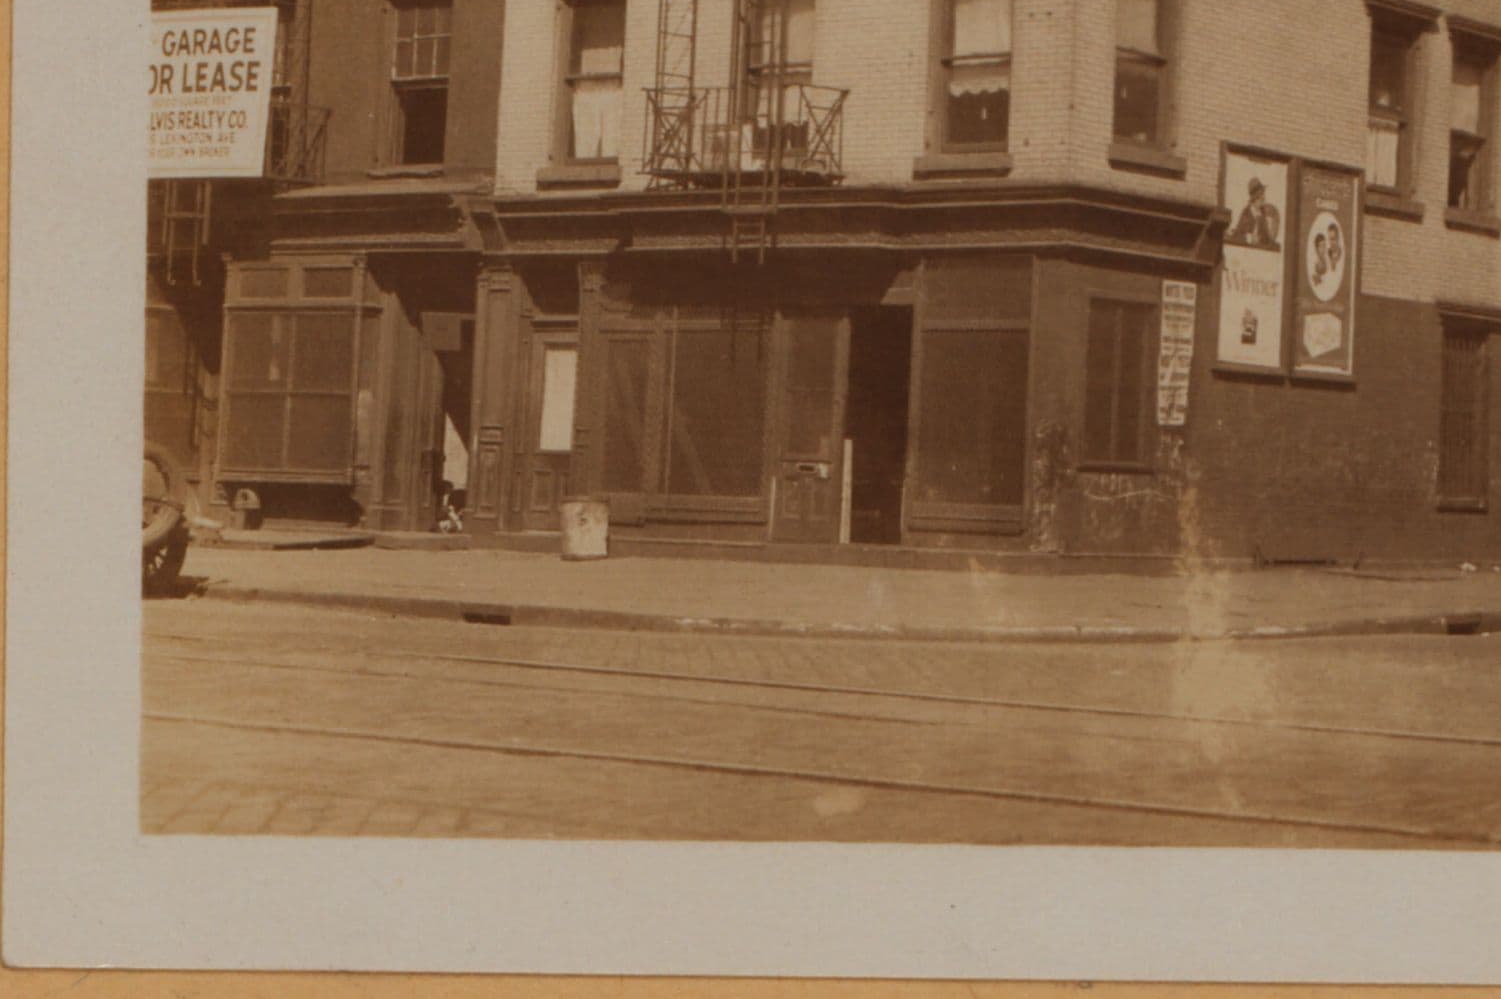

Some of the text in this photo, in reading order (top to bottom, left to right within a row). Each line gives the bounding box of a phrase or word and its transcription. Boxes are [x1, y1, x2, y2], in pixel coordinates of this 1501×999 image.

[162, 28, 257, 56] GARAGE
[181, 60, 261, 93] LEASE
[178, 109, 225, 130] REALTY
[228, 109, 249, 129] CO.
[1223, 266, 1279, 298] Winner
